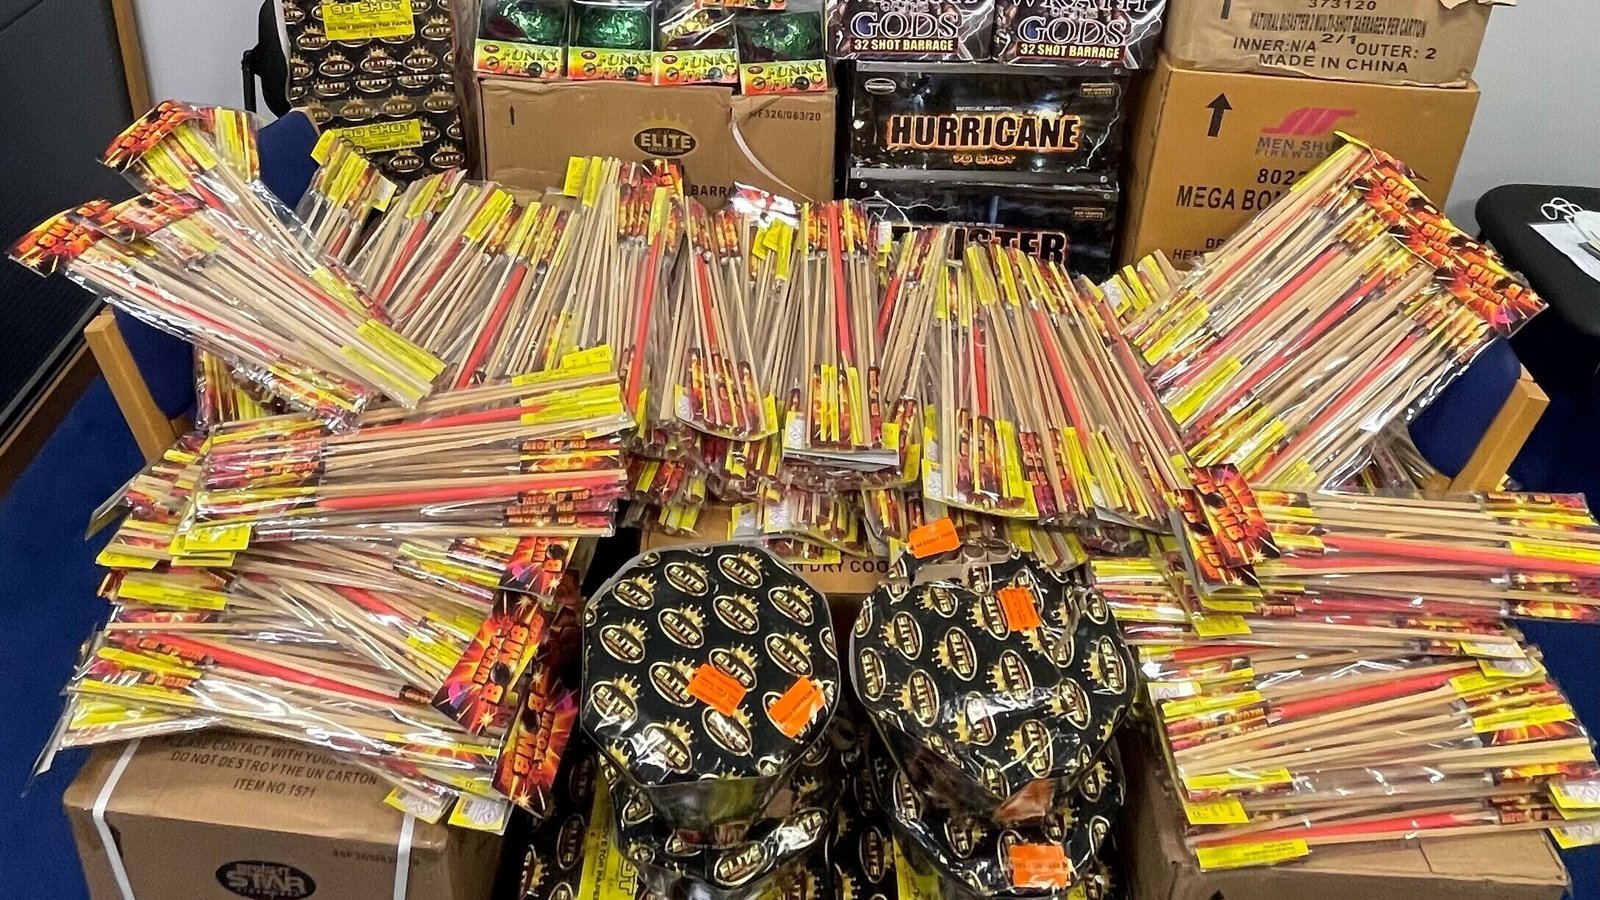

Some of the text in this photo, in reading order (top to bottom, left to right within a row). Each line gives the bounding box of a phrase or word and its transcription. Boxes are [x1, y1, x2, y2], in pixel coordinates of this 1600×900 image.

[359, 0, 402, 13] SHOT
[850, 12, 960, 39] GODS
[1018, 16, 1128, 47] GODS
[854, 39, 954, 51] 32 SHOT BARRAGE
[1020, 43, 1120, 59] 32 SHOT BARRAGE
[1321, 33, 1357, 45] 2/1
[1356, 43, 1418, 59] OUTER:
[1425, 48, 1437, 60] 2
[500, 48, 560, 62] FUNKY
[597, 52, 652, 67] FUNKY
[680, 51, 738, 70] FUNKY
[1258, 53, 1409, 73] MADE IN CHINA
[766, 61, 824, 80] FUNKY
[370, 120, 413, 135] SHOT
[885, 114, 1082, 152] HURRICANE
[640, 132, 692, 150] ELITE
[1256, 136, 1336, 153] MEN SHU
[952, 153, 1017, 165] 90 SHOT
[1176, 185, 1236, 210] MEGA
[668, 565, 706, 591] ELITE
[722, 556, 759, 584] ELITE
[810, 561, 844, 573] DRY
[851, 561, 888, 573] COO
[618, 581, 652, 607] ELITE
[772, 591, 810, 622] ELITE
[662, 610, 701, 643] ELITE
[716, 598, 756, 630] ELITE
[984, 595, 1005, 634] ELITE
[604, 628, 639, 659] ELITE
[897, 616, 916, 655] ELITE
[479, 622, 530, 706] BOMB
[769, 638, 808, 672] ELITE
[949, 631, 972, 675] ELITE
[713, 652, 754, 687] ELITE
[860, 653, 880, 694] ELITE
[596, 684, 633, 719] ELITE
[913, 675, 933, 721] ELITE
[214, 738, 270, 757] CONTACT
[271, 748, 302, 761] WITH
[171, 751, 379, 786] DO NOT DESTROY THE UN CARTON
[233, 777, 264, 790] ITEM
[289, 784, 317, 799] 1571
[719, 842, 761, 876] ELITE
[226, 871, 308, 894] STAR
